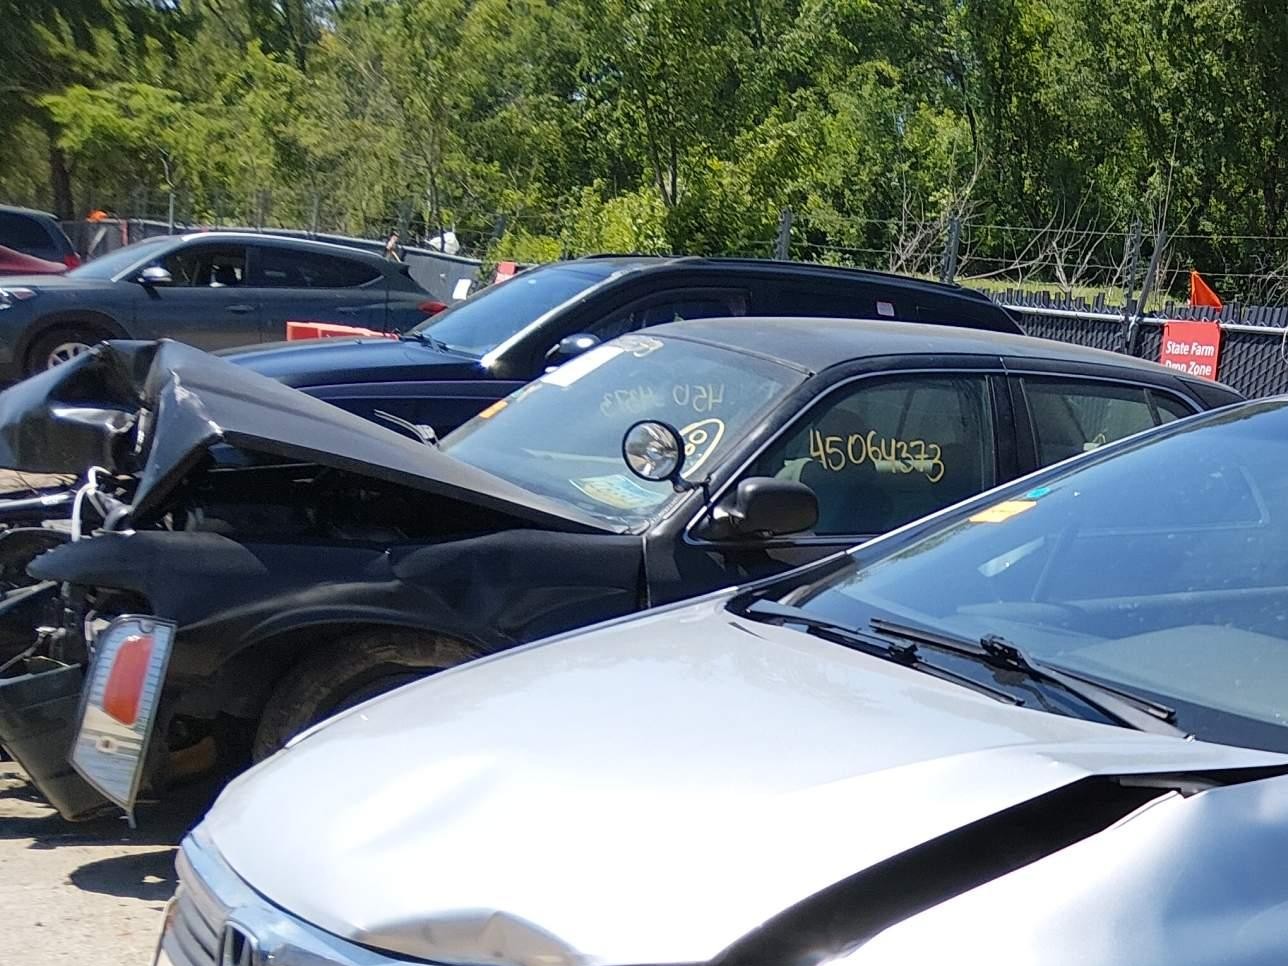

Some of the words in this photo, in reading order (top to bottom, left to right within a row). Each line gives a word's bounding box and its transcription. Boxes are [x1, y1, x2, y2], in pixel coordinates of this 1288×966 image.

[1165, 341, 1190, 355] State
[1190, 342, 1215, 357] Farm
[1188, 361, 1212, 376] Zone
[809, 428, 945, 483] 45064373
